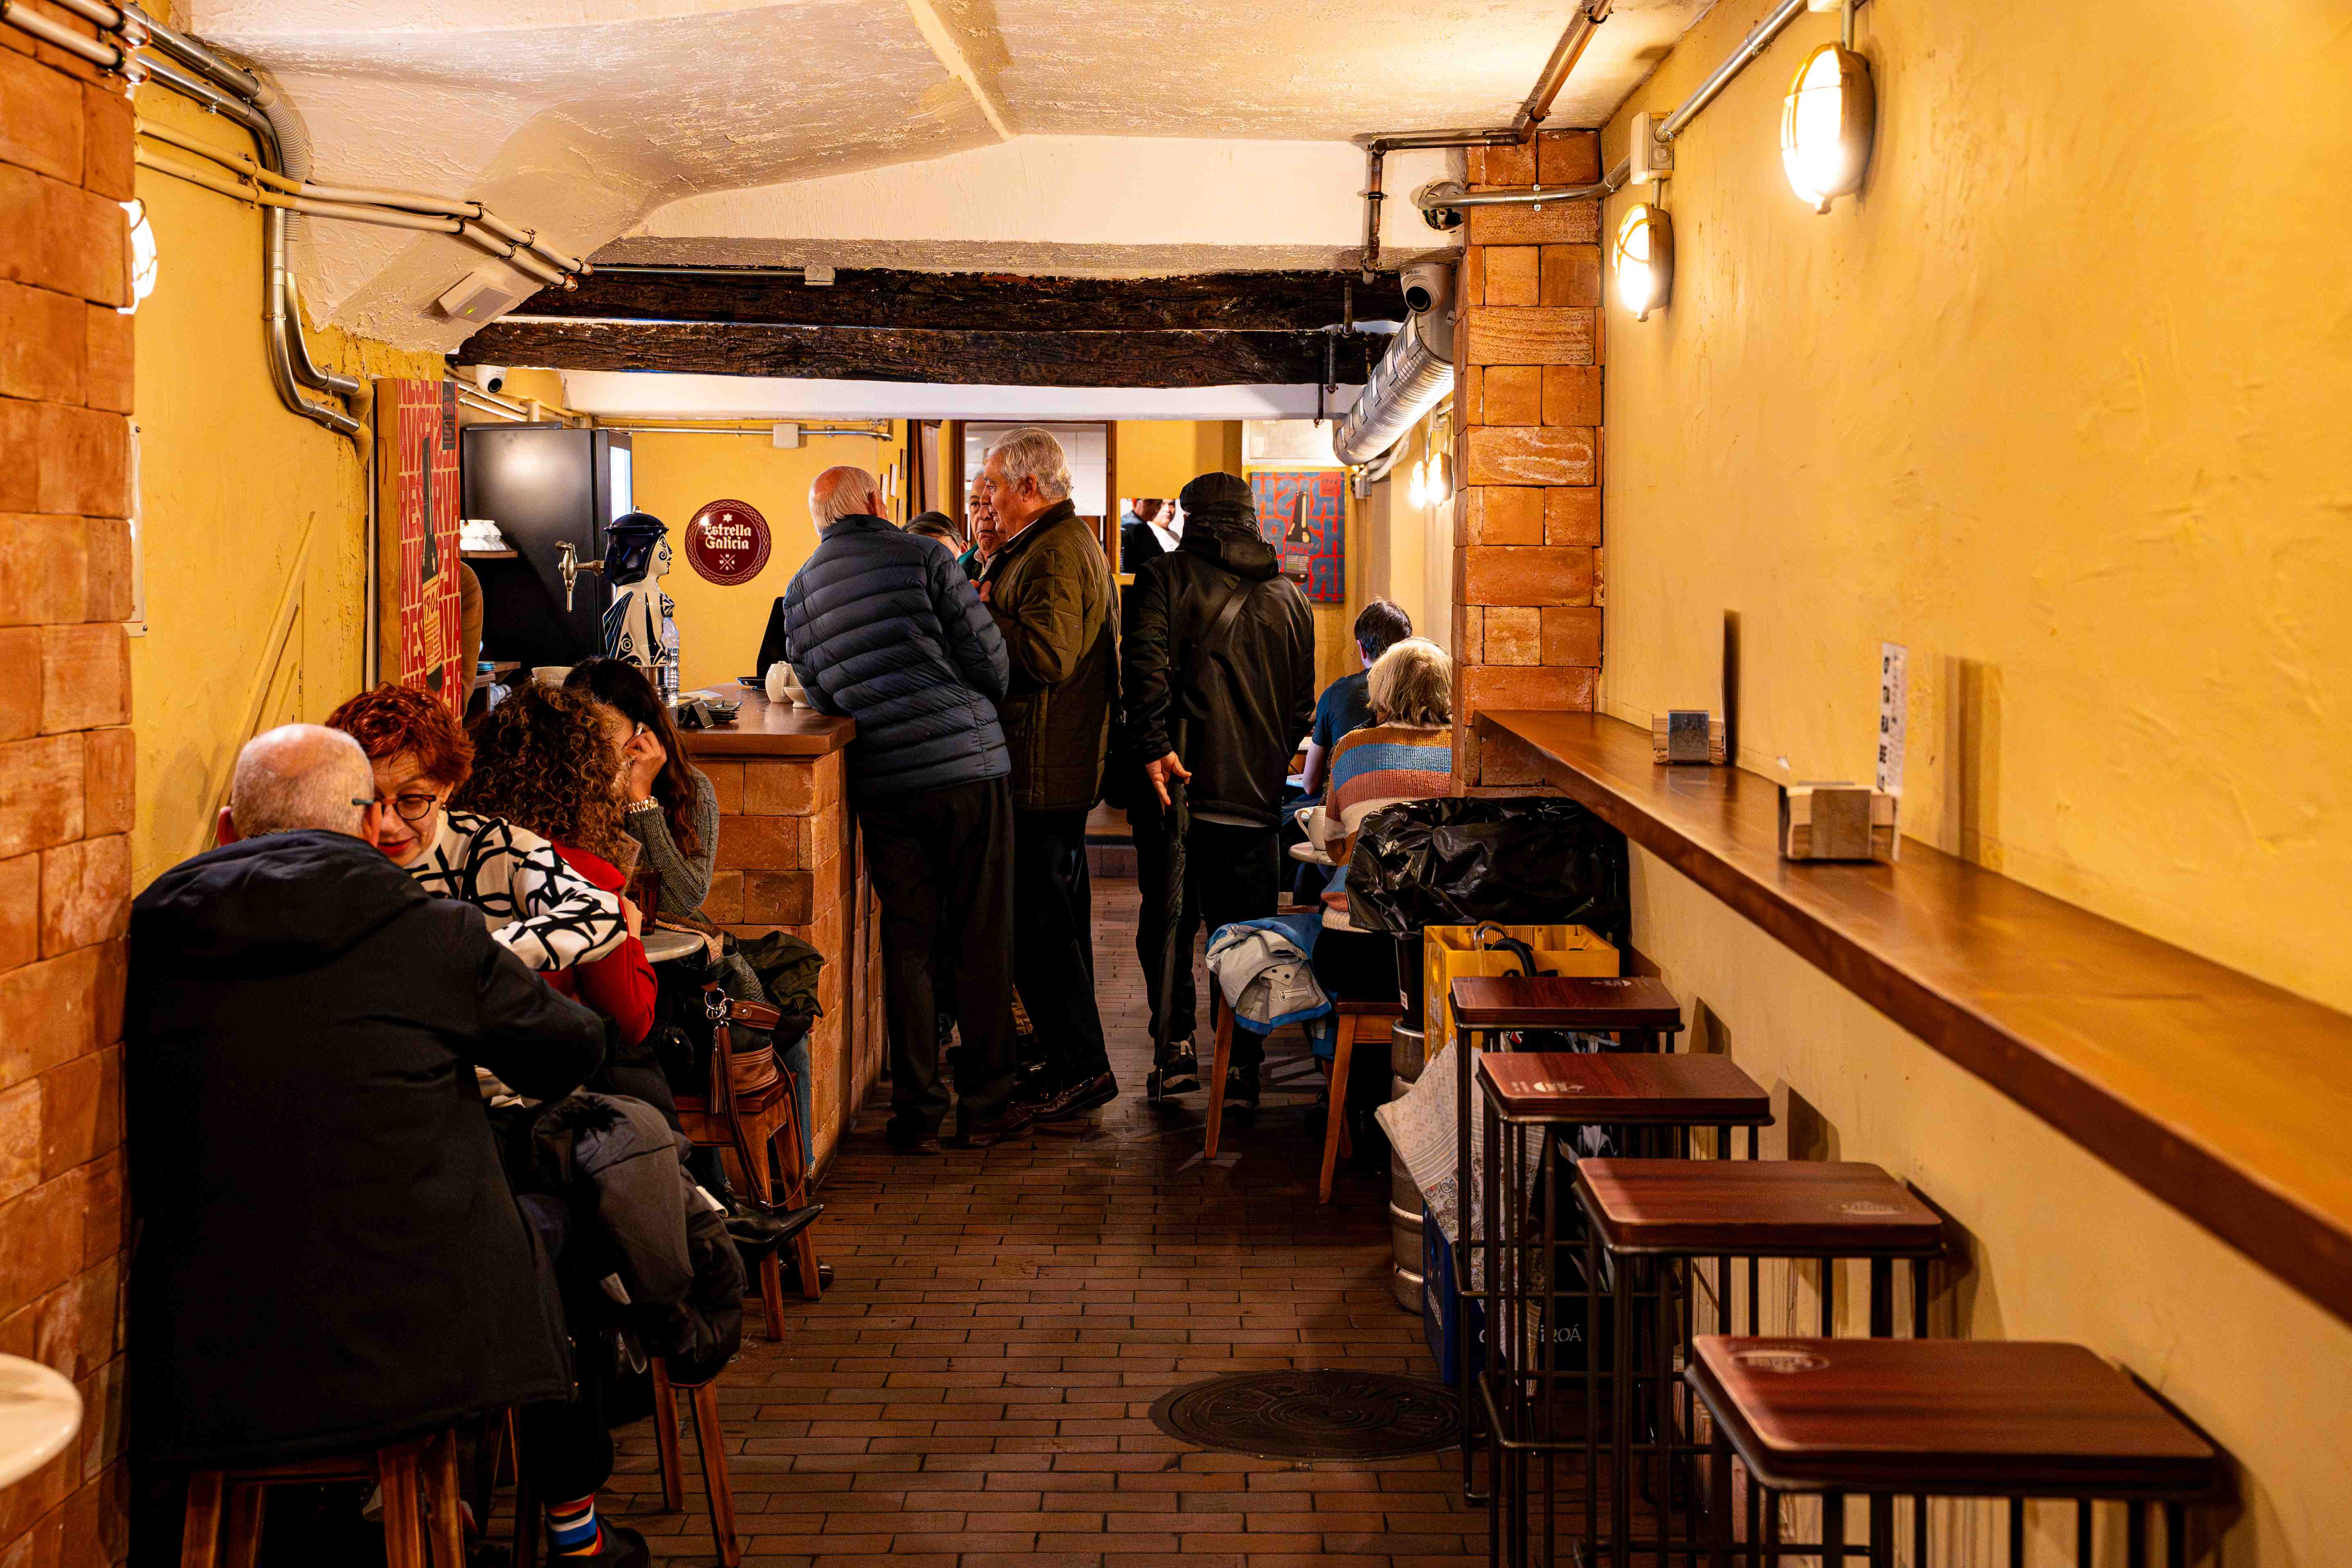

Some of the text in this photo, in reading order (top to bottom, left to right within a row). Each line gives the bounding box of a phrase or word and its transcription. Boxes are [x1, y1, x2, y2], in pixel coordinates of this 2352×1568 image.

[399, 472, 460, 541] RESRVA
[704, 524, 751, 537] Estrella
[705, 537, 749, 549] Galicia
[424, 587, 438, 621] 1906
[401, 595, 461, 677] RESRVA
